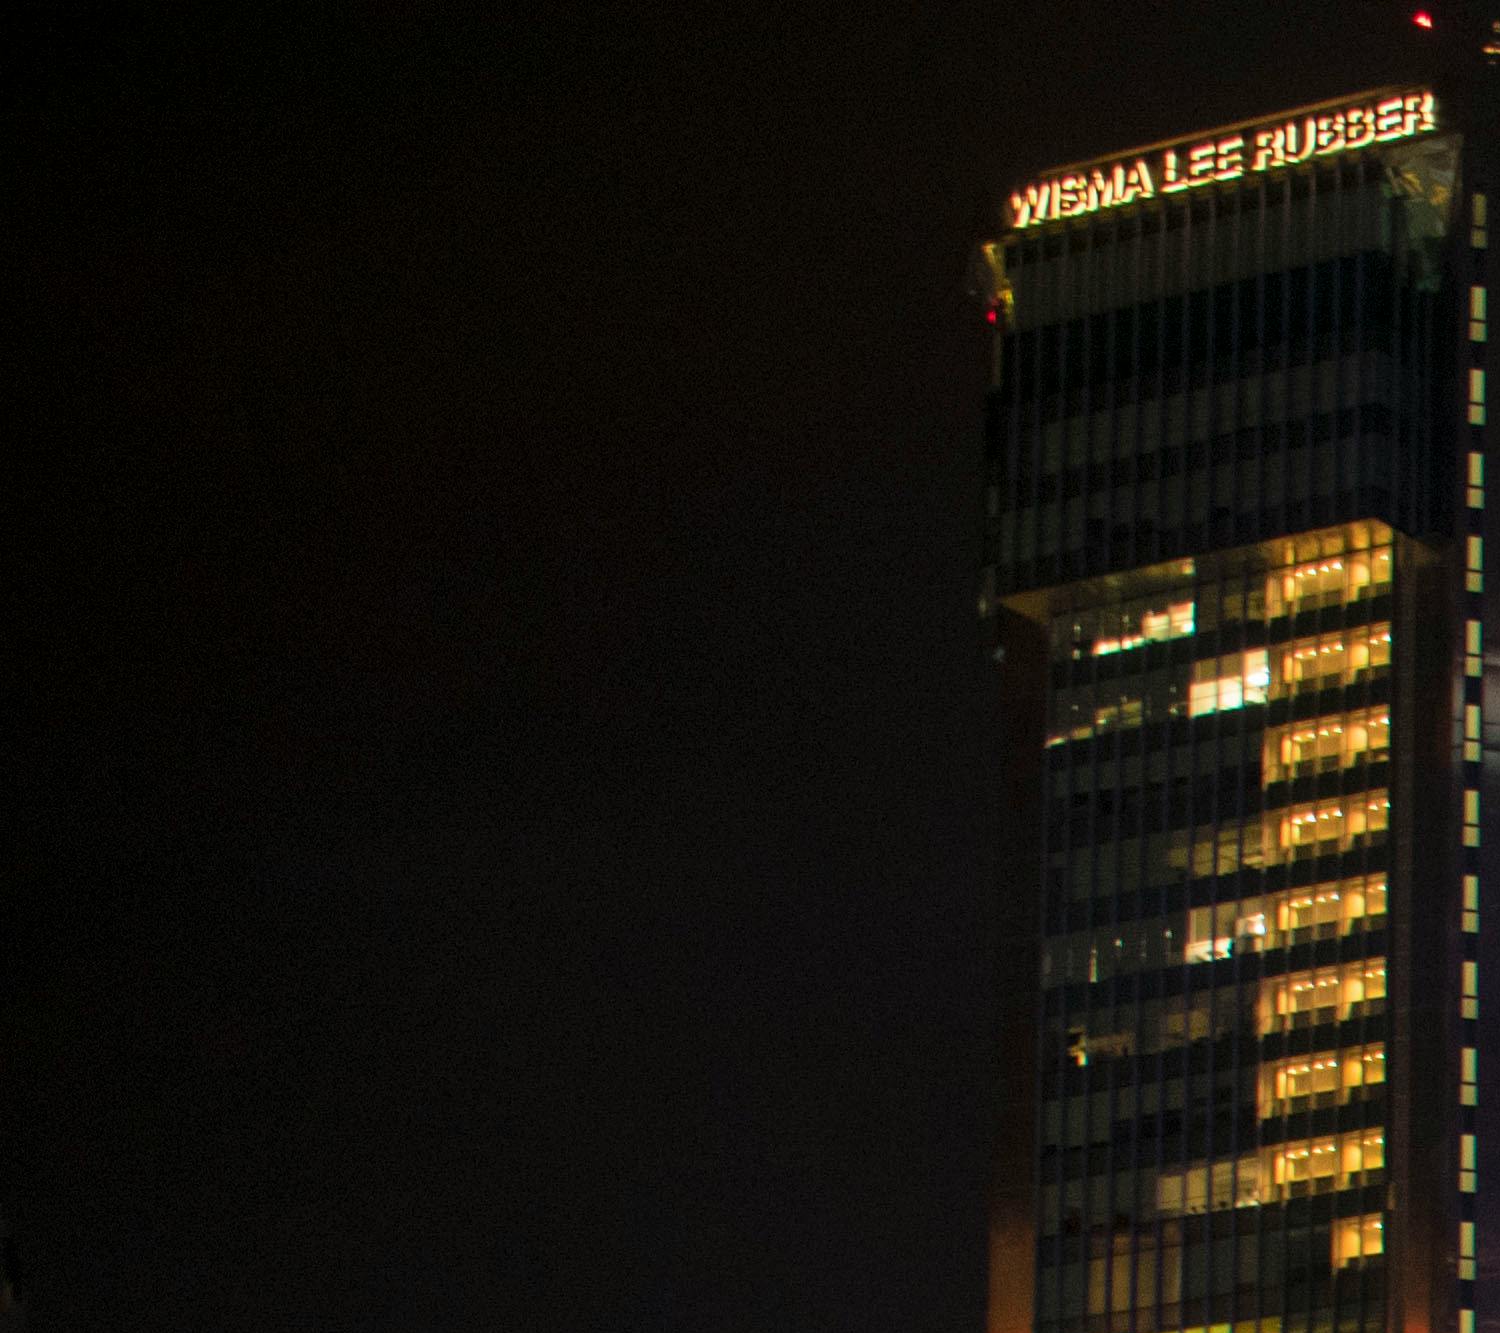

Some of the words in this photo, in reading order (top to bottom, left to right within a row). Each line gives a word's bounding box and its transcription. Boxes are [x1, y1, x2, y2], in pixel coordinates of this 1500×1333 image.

[1009, 159, 1155, 228] WISMA
[1160, 136, 1244, 194] LEE
[1252, 91, 1437, 171] RUBBER
